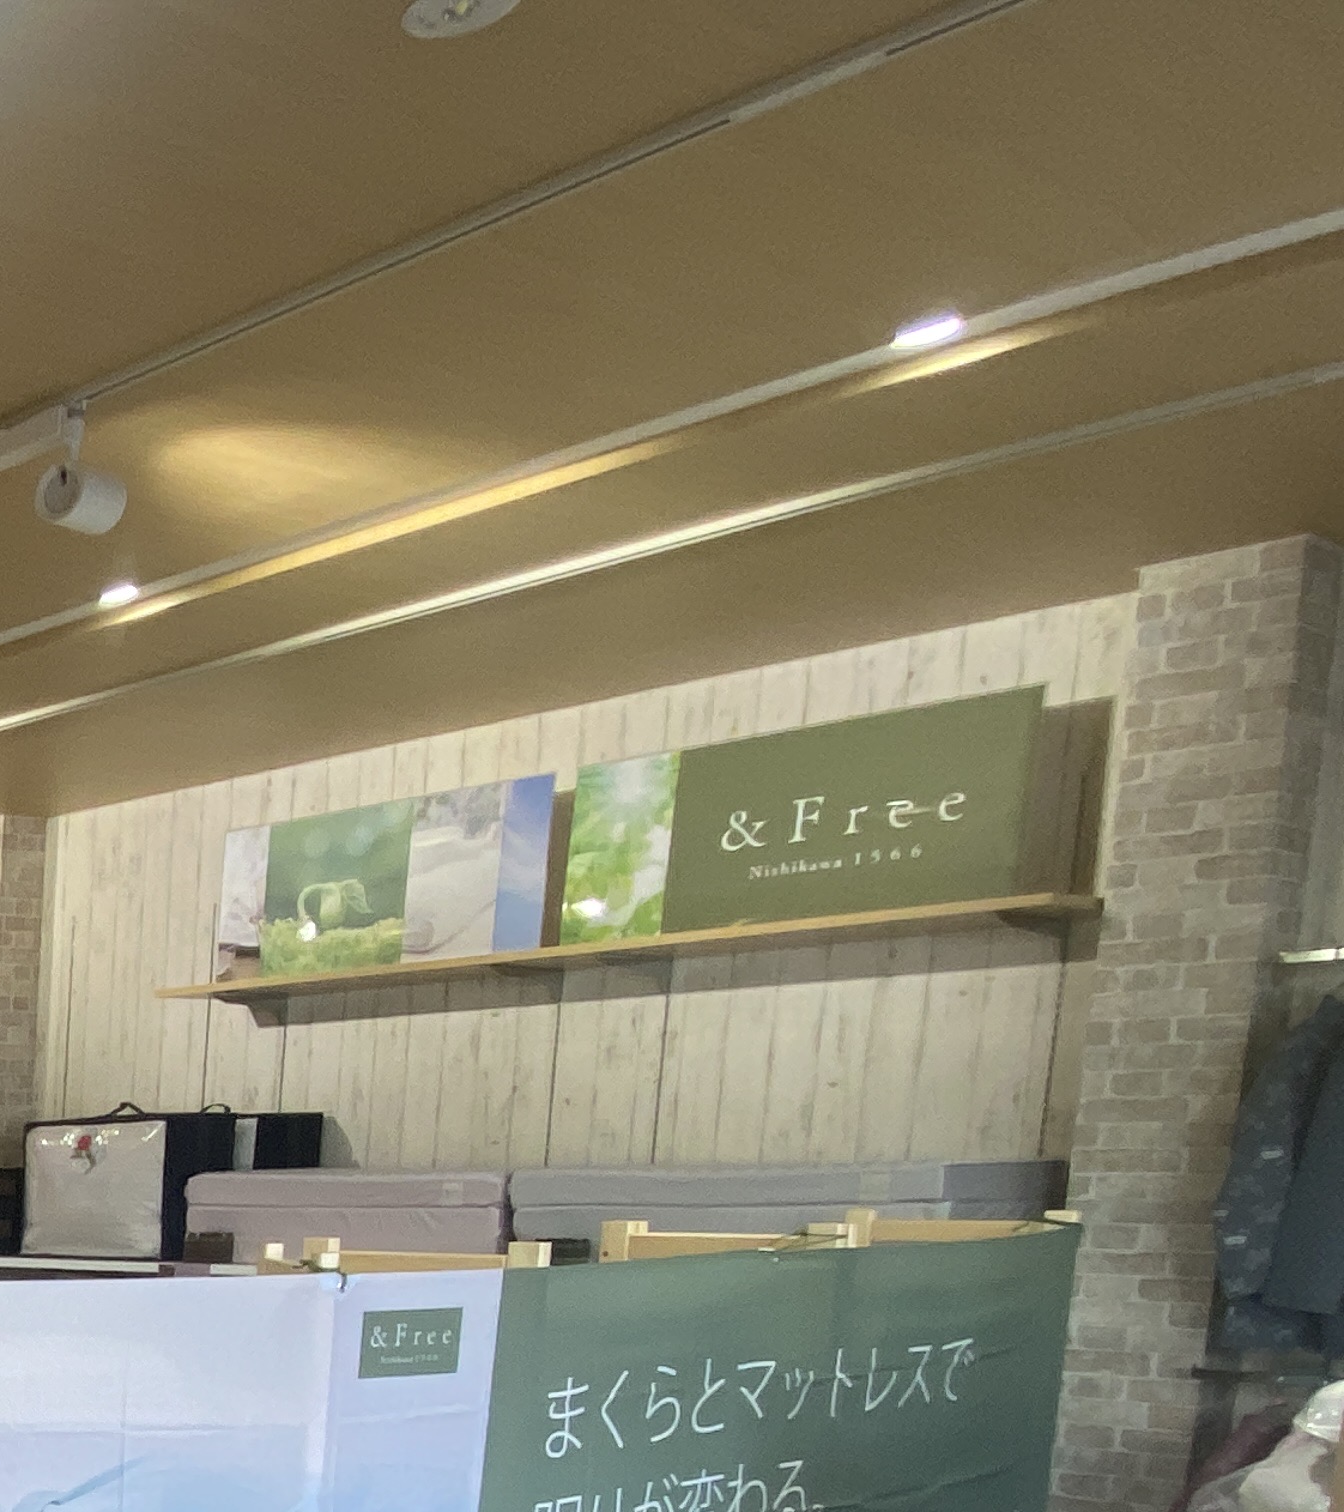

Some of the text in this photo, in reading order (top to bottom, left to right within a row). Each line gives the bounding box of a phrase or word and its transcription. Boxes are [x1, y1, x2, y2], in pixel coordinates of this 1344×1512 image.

[720, 792, 966, 851] & Free
[370, 1322, 452, 1348] & Free
[545, 1337, 976, 1458] まくらとマットレスで
